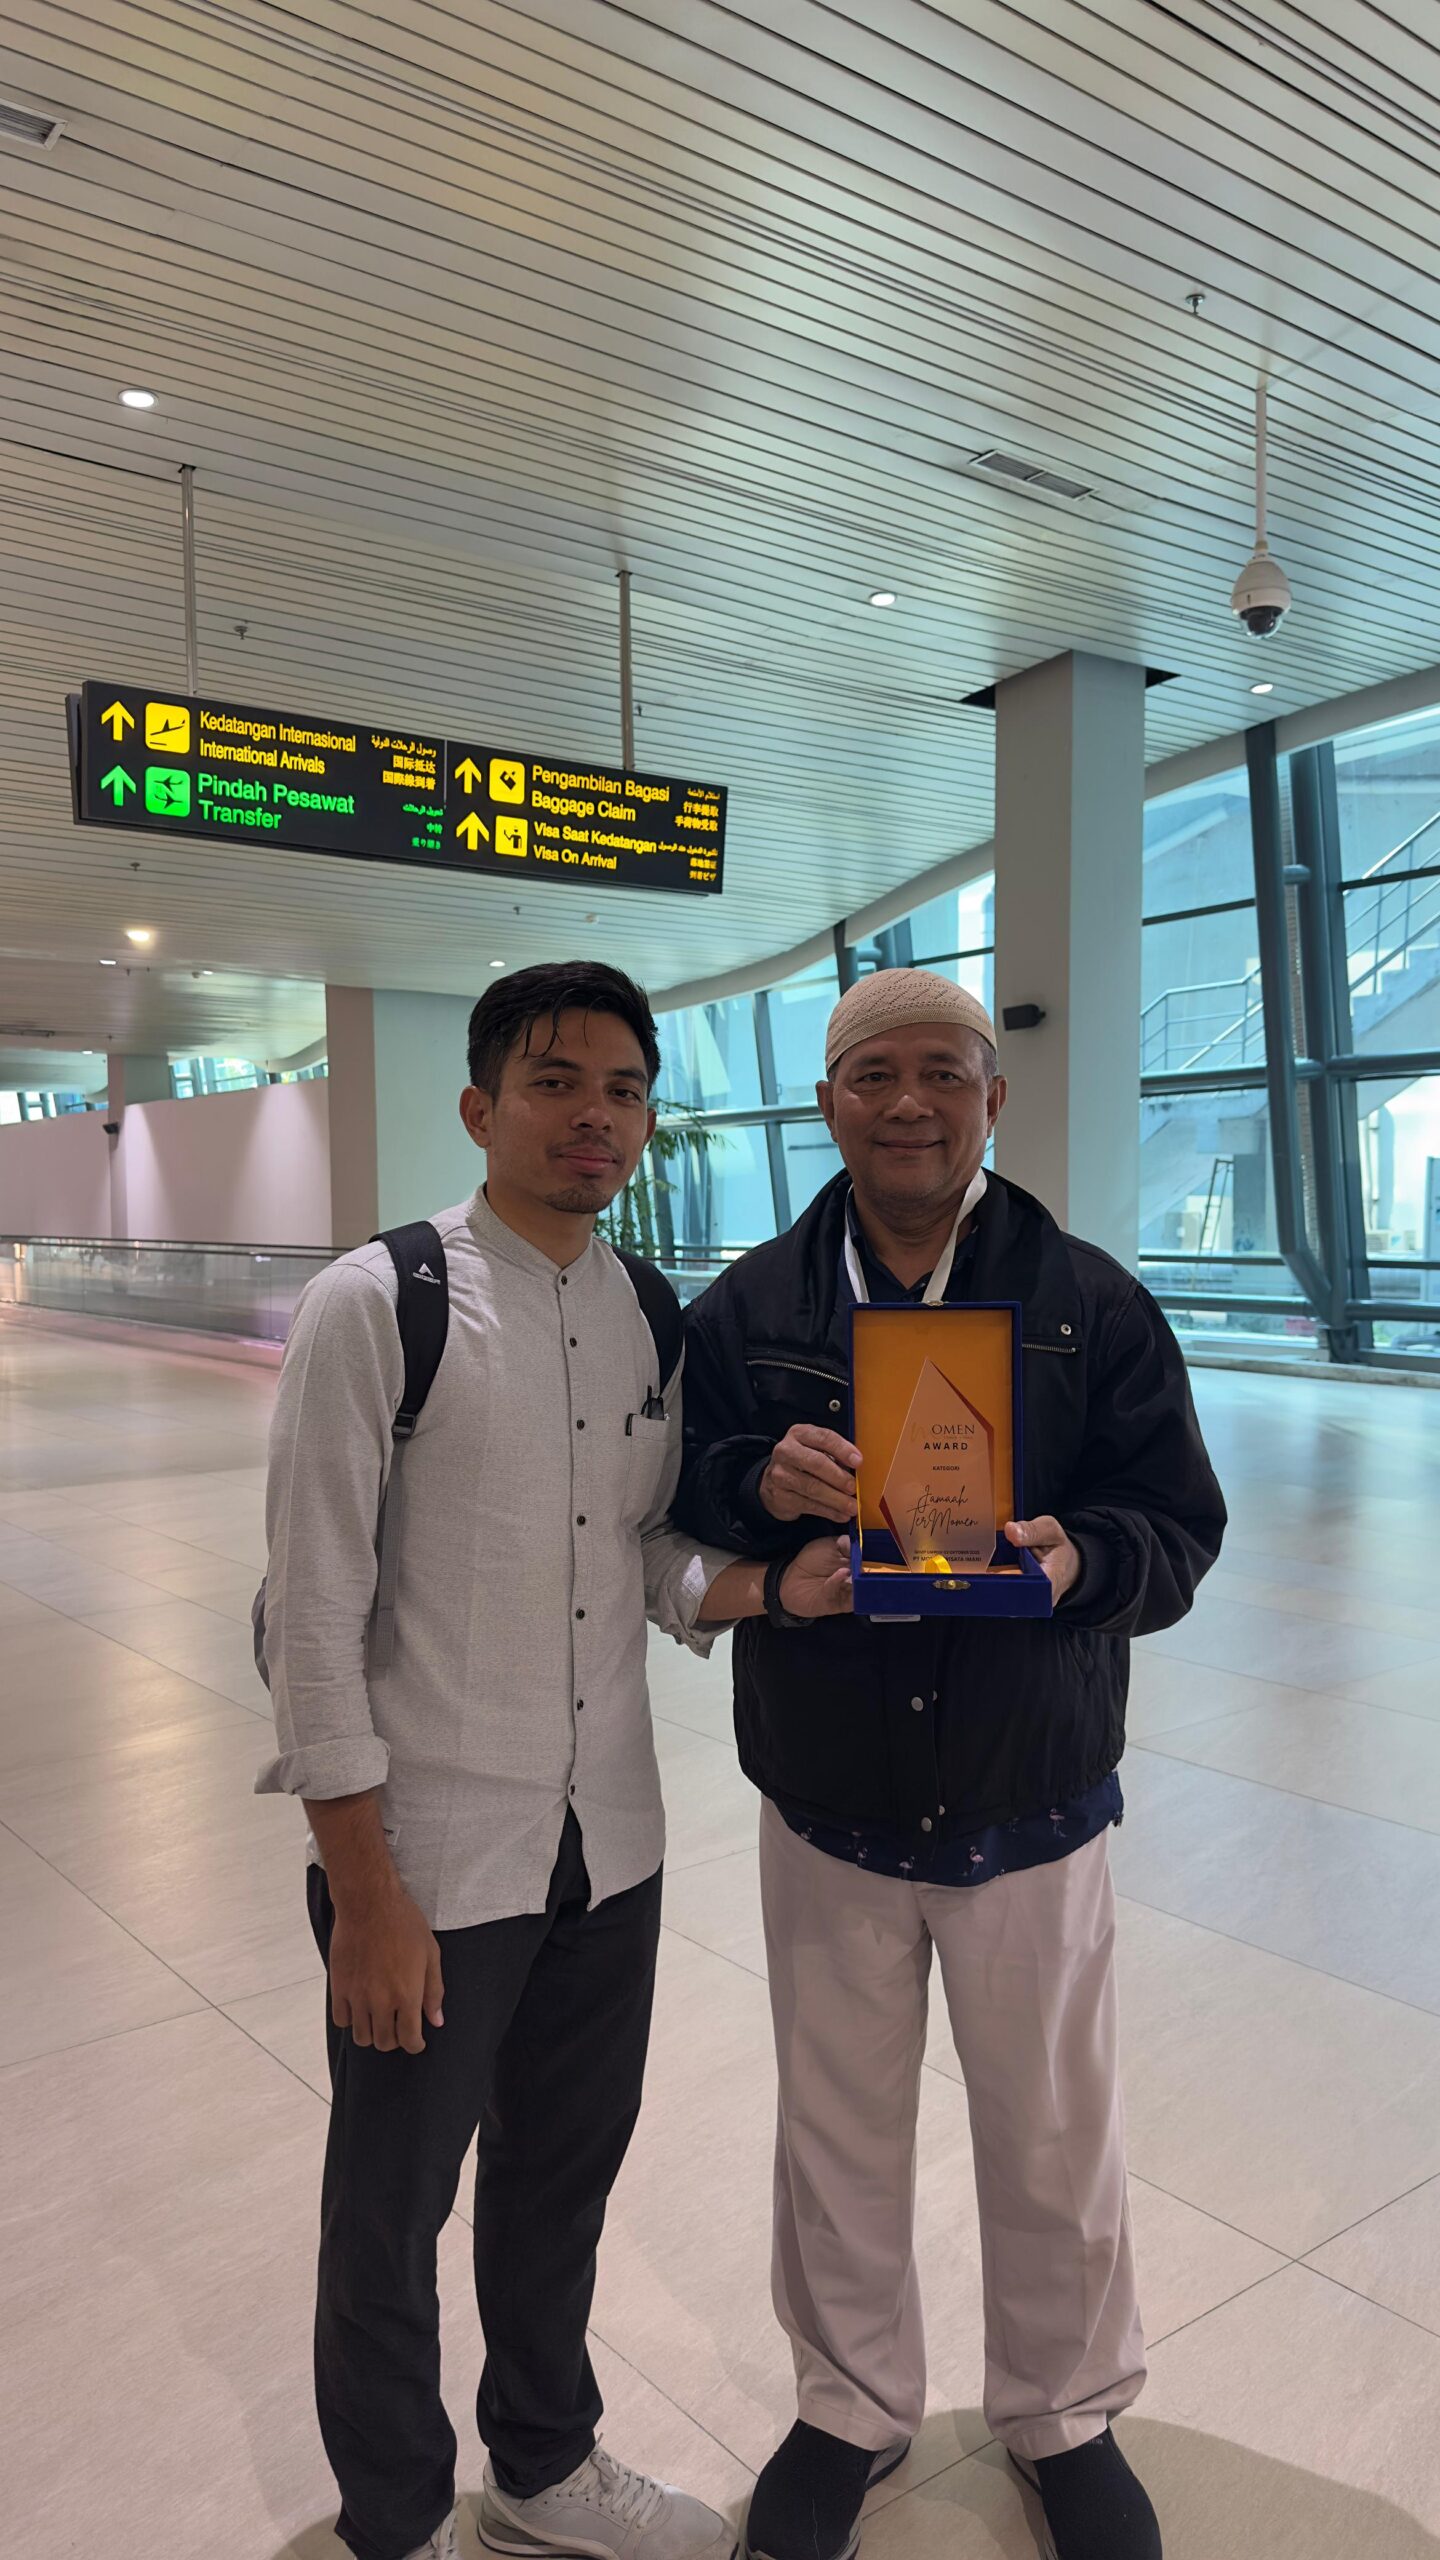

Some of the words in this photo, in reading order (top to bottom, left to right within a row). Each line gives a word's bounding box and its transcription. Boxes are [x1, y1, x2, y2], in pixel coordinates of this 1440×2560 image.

[200, 711, 277, 741] Kedatangan
[279, 723, 356, 752] Internasional
[200, 738, 278, 767] International
[280, 751, 325, 774] Arrivals
[197, 772, 267, 802] Pindah
[273, 783, 355, 814] Pesawat
[532, 765, 622, 794] Pengambilan
[625, 780, 670, 803] Bagasi
[198, 799, 282, 829] Transfer
[532, 790, 595, 818] Baggage
[598, 800, 636, 821] Claim
[534, 821, 560, 838] Visa
[562, 825, 589, 843] Saat
[591, 830, 657, 854] Kedatangan
[533, 844, 560, 861] Visa
[561, 848, 579, 864] On
[581, 852, 617, 870] Arrival
[923, 1442, 968, 1450] AWARD
